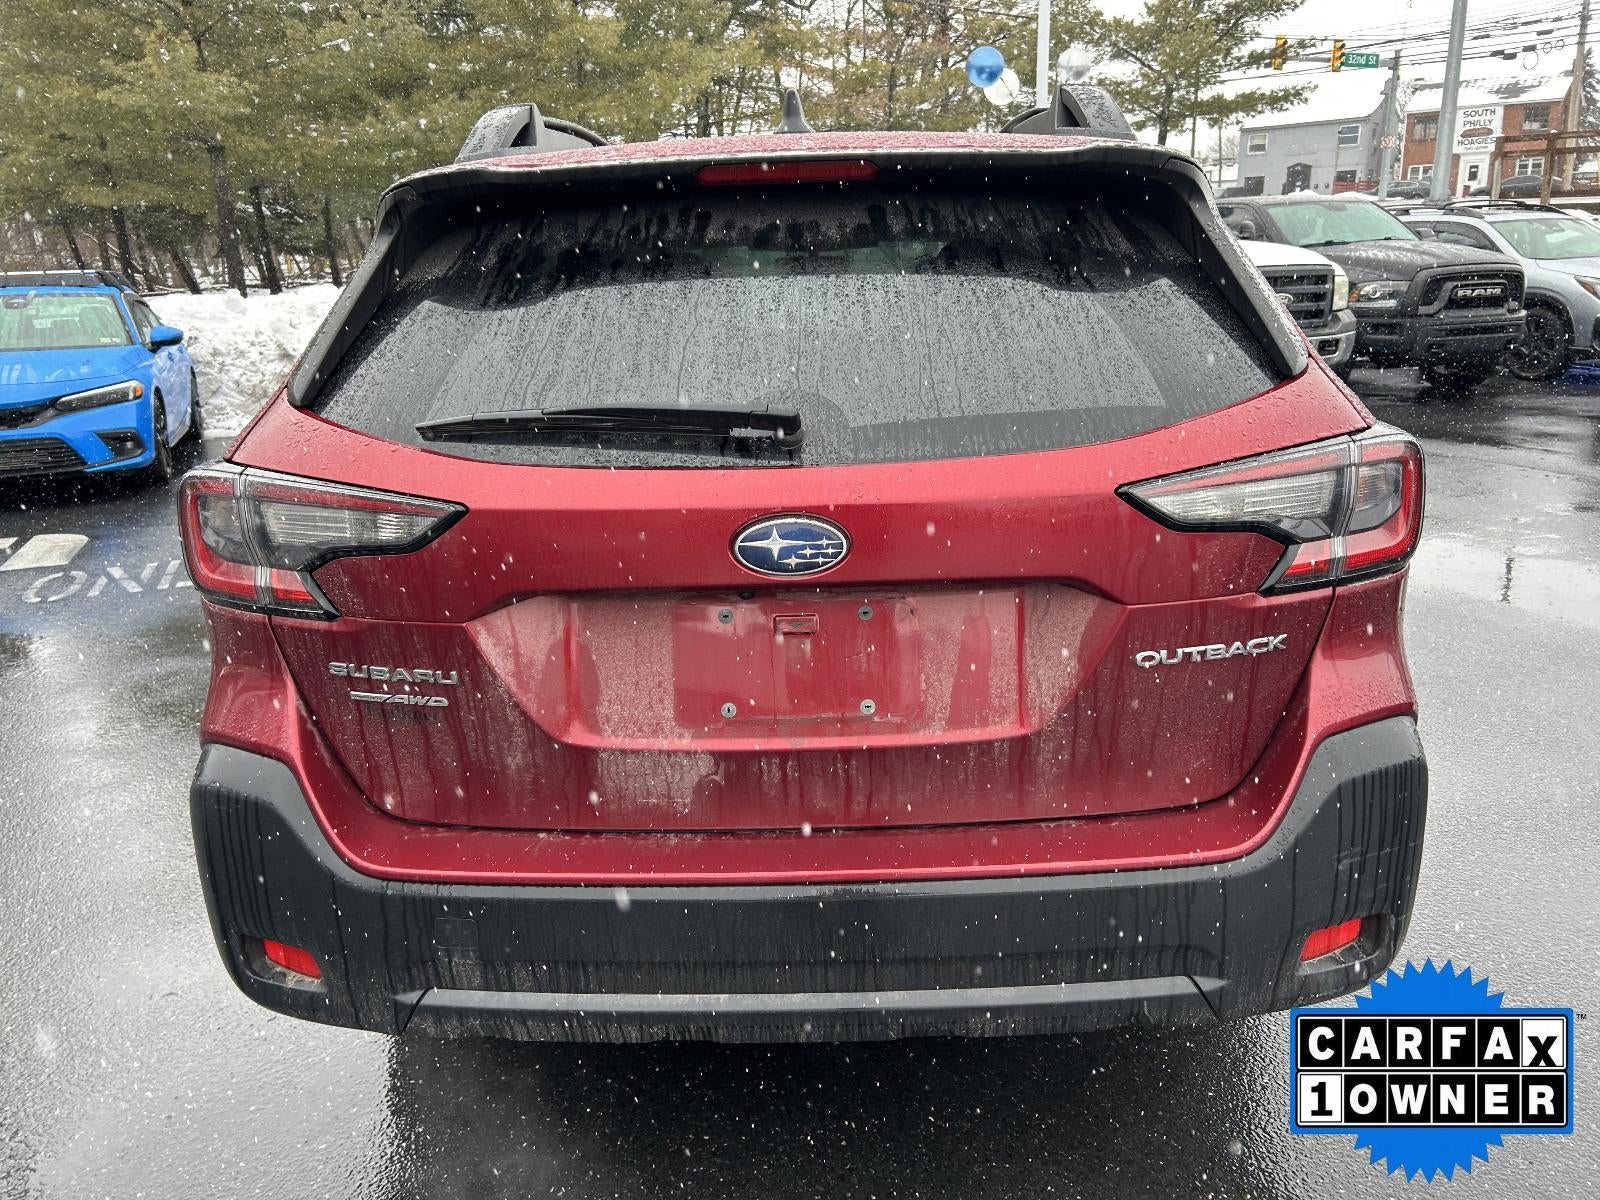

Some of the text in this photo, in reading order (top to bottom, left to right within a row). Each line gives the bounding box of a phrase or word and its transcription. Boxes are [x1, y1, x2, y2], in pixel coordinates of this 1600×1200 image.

[1348, 54, 1367, 64] 32nd
[1368, 55, 1377, 65] St
[1463, 108, 1496, 118] SOUTH
[1463, 119, 1493, 127] PHILLY
[1457, 136, 1496, 146] HOAGIES
[1457, 288, 1502, 297] RAM
[22, 560, 193, 603] ONL
[1135, 633, 1288, 668] OUTBACK
[328, 661, 458, 685] SUBARU
[385, 694, 449, 707] AWD
